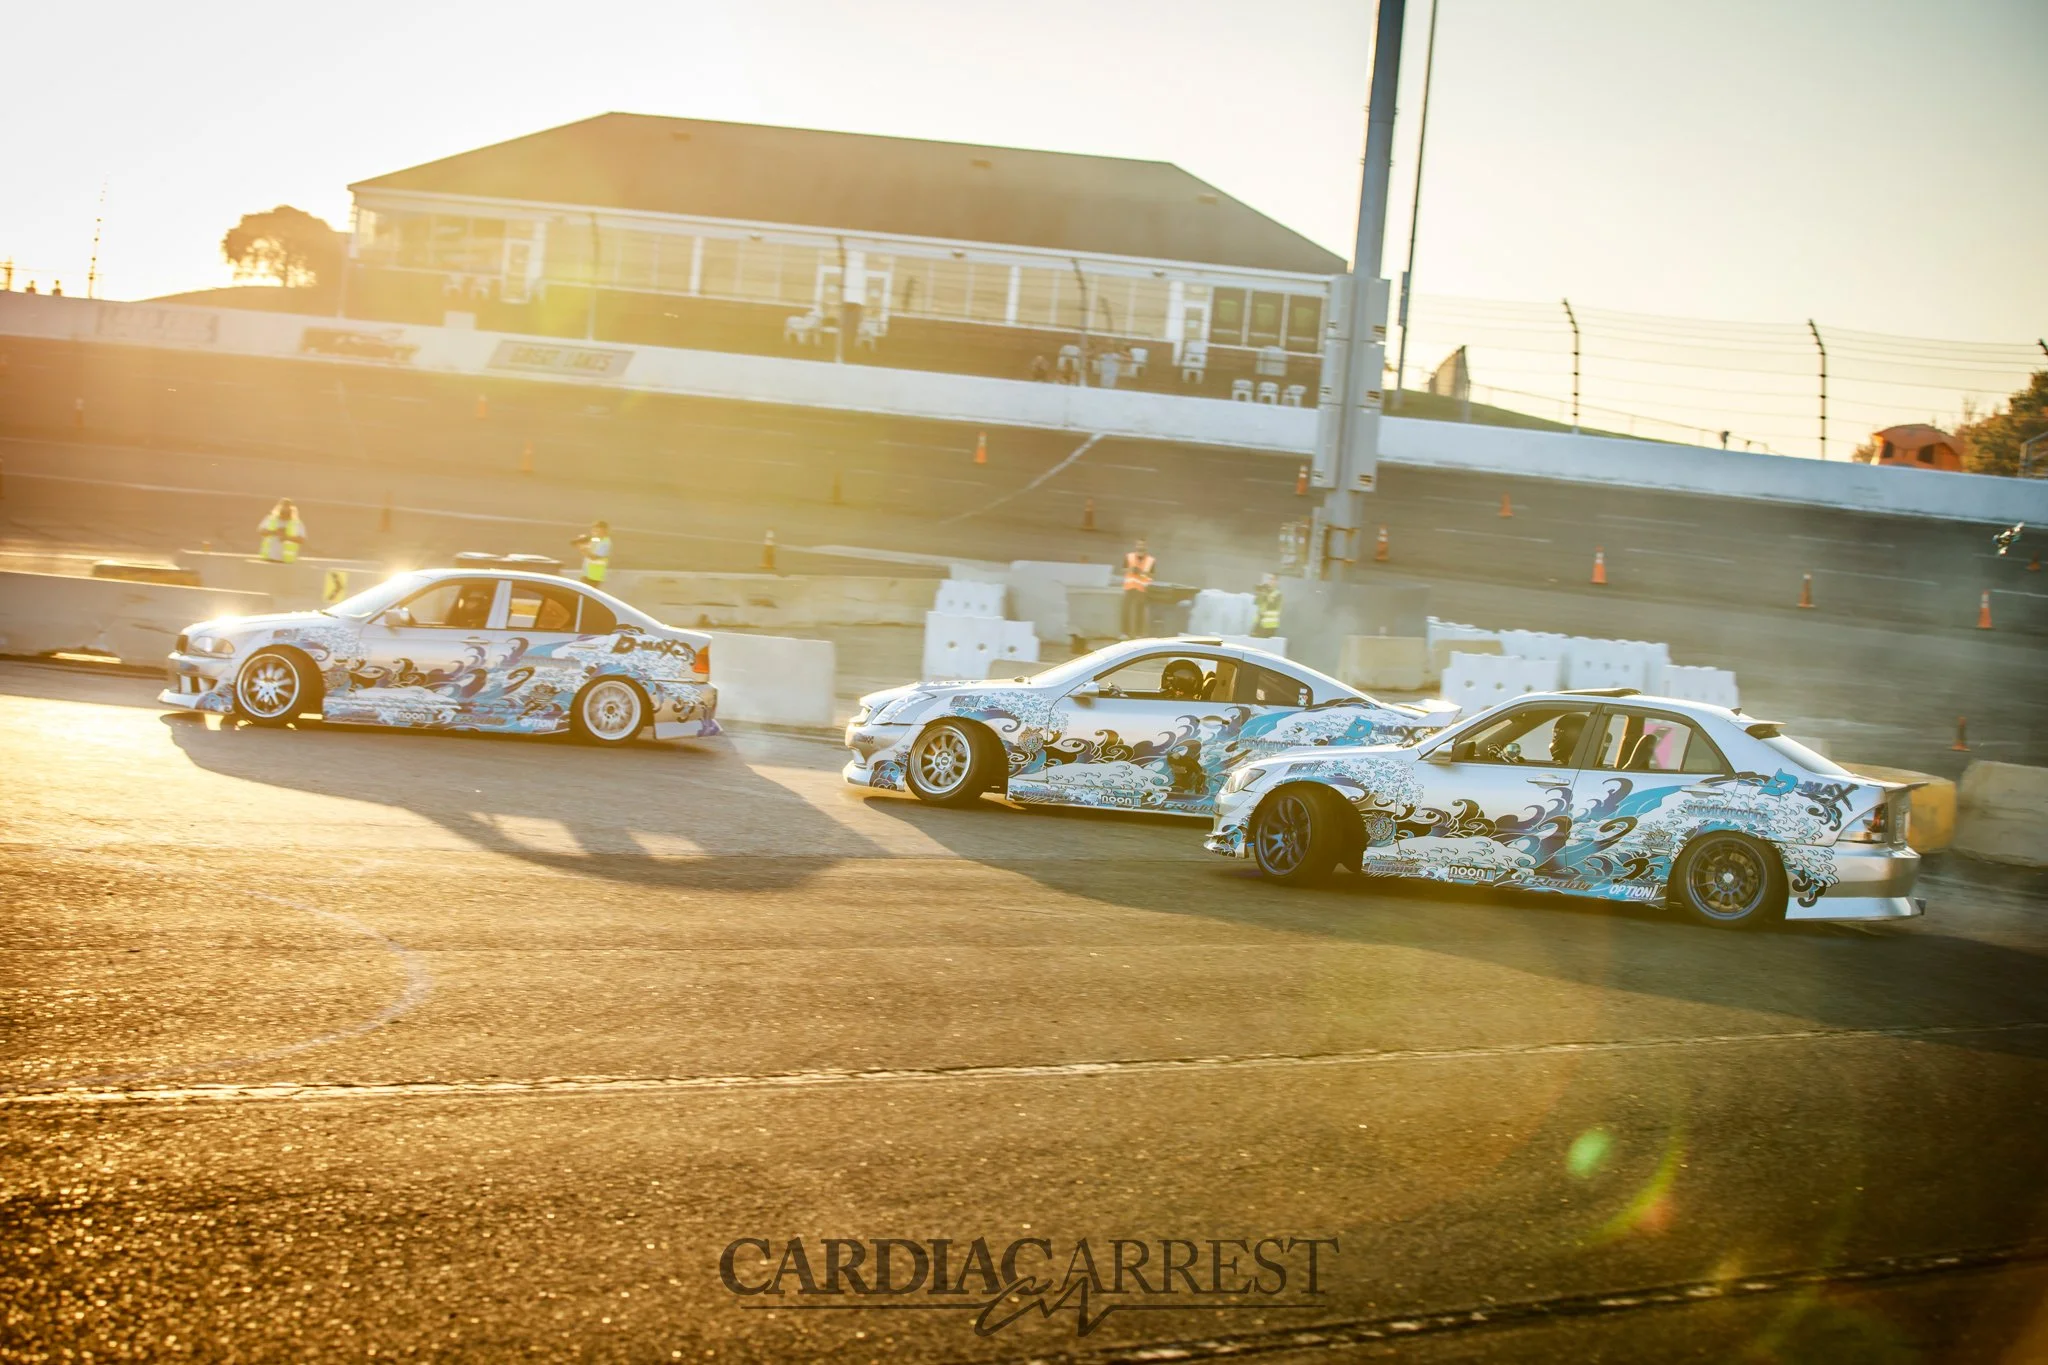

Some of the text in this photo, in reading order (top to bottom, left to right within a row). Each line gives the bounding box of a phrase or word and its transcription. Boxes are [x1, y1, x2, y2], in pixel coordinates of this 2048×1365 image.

[1757, 768, 1860, 812] D-MAX
[1101, 795, 1133, 805] noon
[1450, 865, 1485, 878] noon
